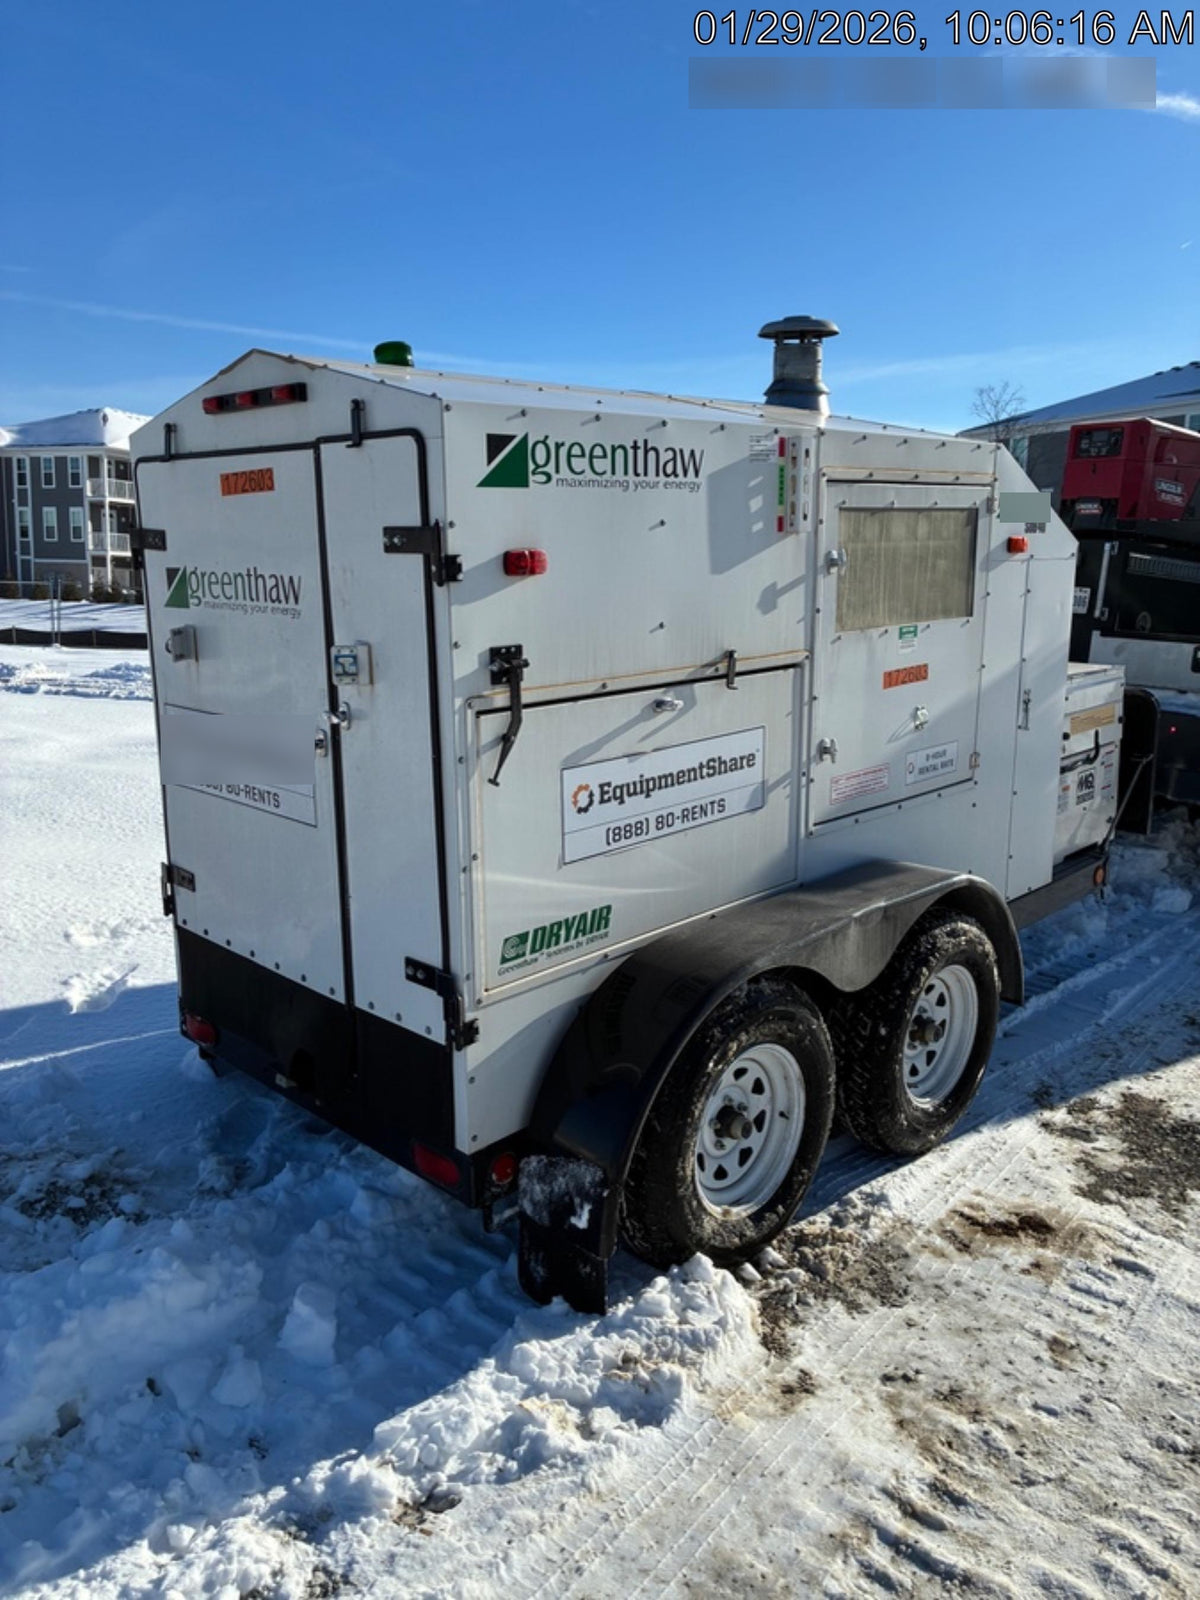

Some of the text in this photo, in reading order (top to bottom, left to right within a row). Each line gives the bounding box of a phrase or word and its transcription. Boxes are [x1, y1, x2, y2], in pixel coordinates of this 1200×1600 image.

[222, 468, 274, 495] 172603
[530, 434, 704, 485] greenthaw
[556, 476, 703, 493] maximizing your energy
[188, 566, 302, 607] greenthaw
[203, 599, 302, 619] maximizing your energy
[598, 751, 757, 805] EquipmentShare
[605, 798, 726, 846] (888) 80-RENTS
[529, 904, 612, 955] DRYAIR
